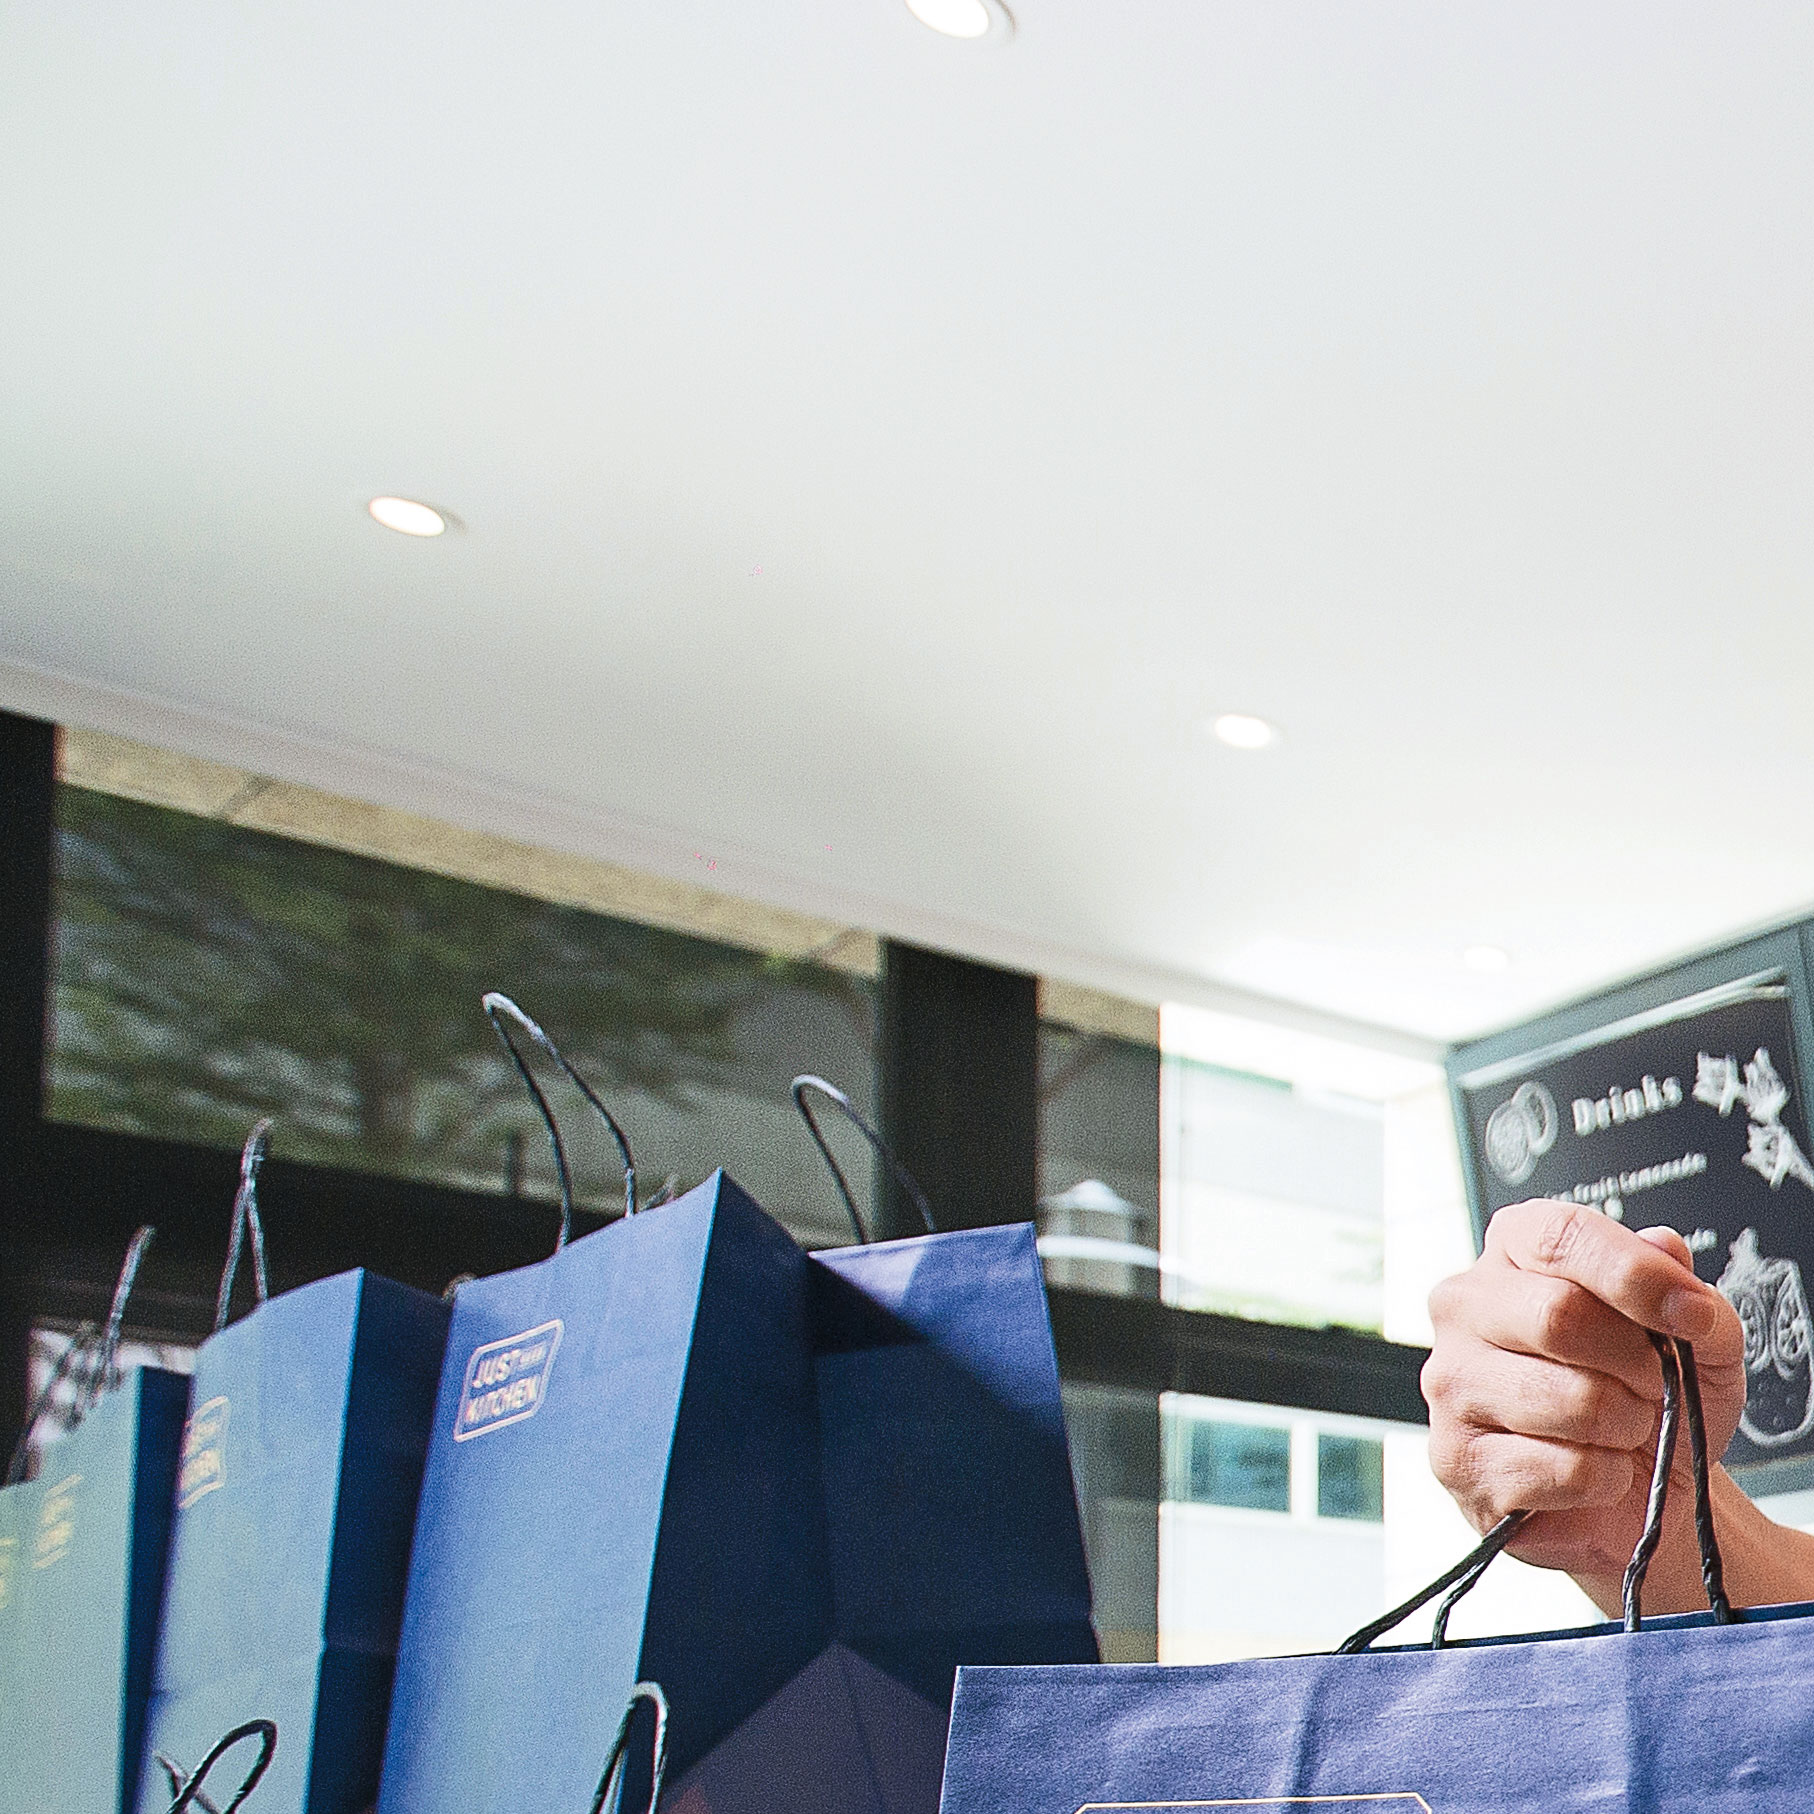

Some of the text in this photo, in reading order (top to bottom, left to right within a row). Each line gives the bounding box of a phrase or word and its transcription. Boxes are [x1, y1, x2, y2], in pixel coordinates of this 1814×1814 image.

[1571, 1074, 1684, 1137] Drinks
[1619, 1151, 1708, 1197] Lemonade
[472, 1349, 522, 1388] JUST
